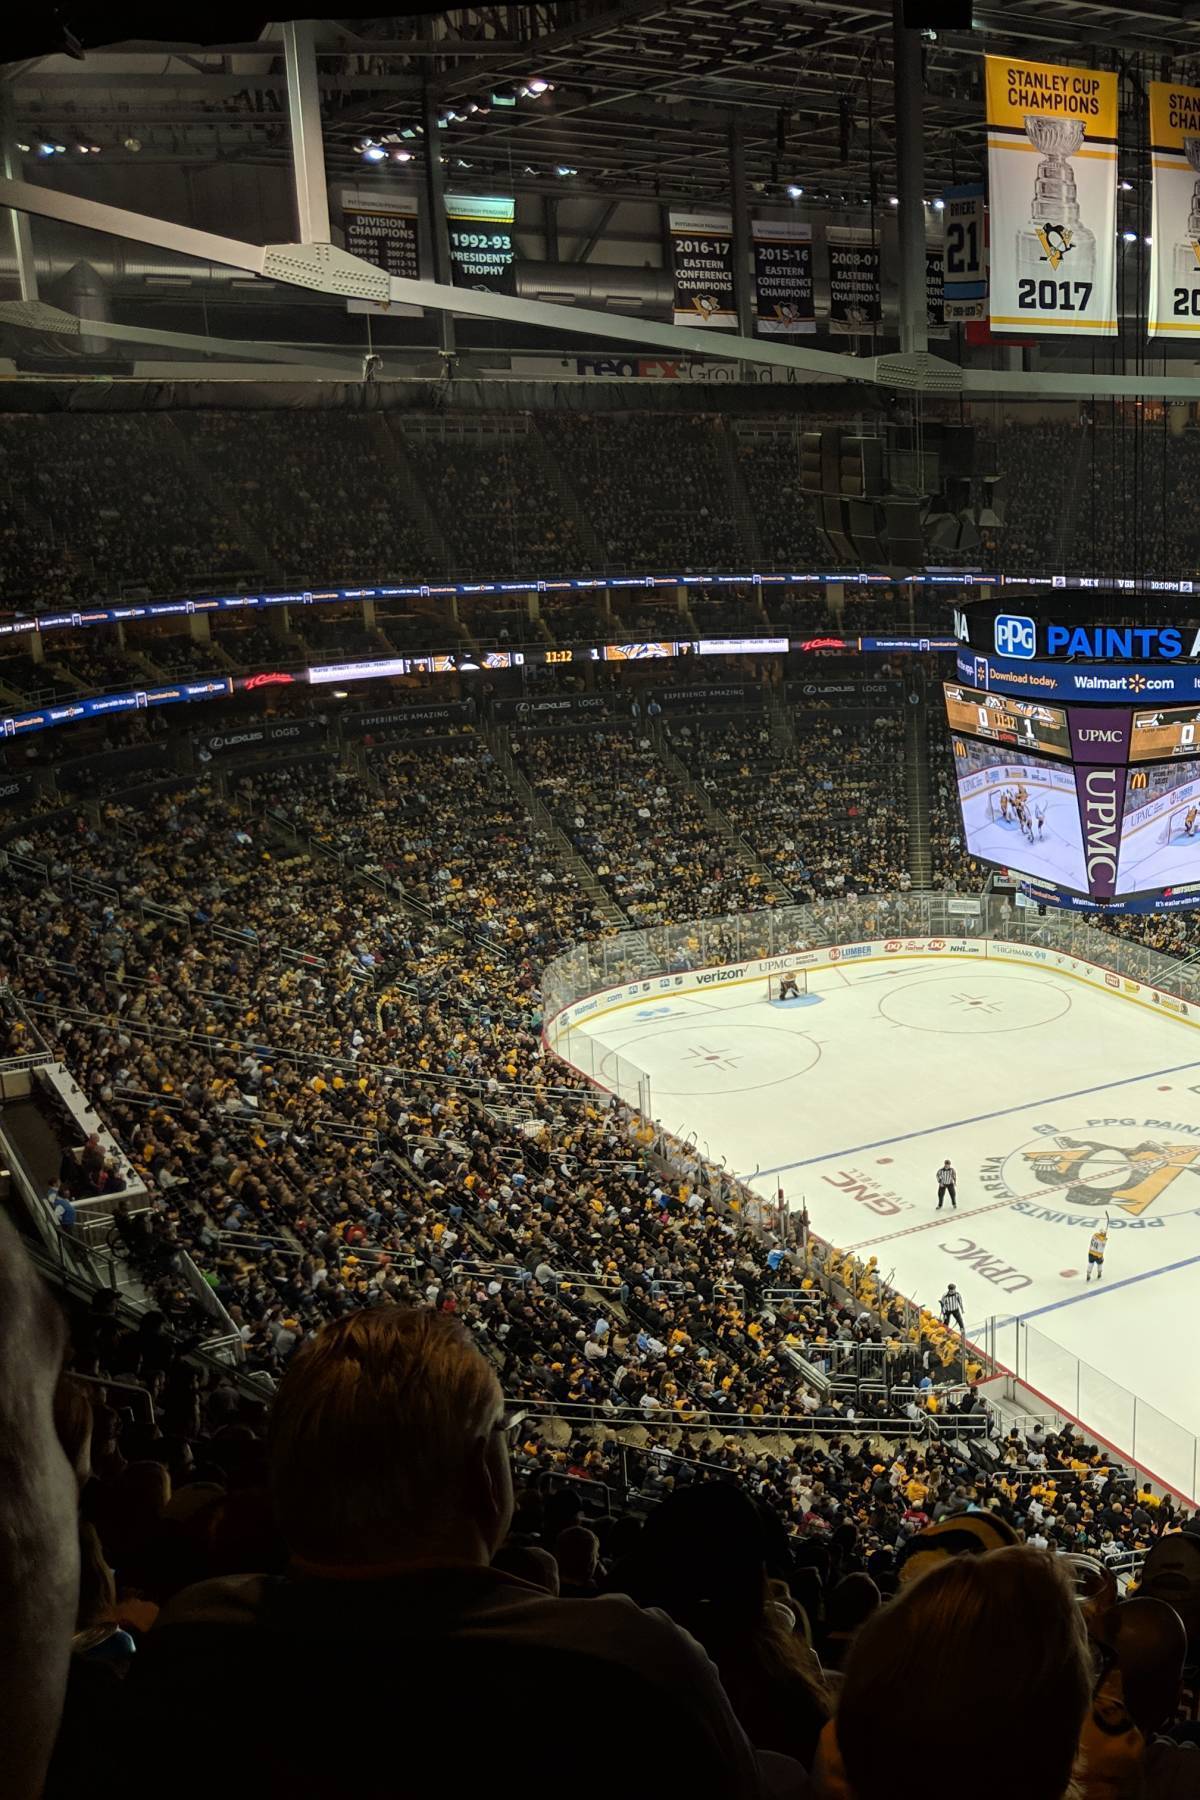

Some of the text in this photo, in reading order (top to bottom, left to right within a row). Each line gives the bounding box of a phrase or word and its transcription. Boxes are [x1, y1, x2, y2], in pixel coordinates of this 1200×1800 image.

[1007, 69, 1100, 95] STANLEY CUP
[1008, 87, 1100, 115] CHAMPIONS
[357, 216, 406, 228] DIVISION
[349, 226, 415, 239] CHAMPIONS
[452, 233, 512, 250] 1992-93
[676, 240, 730, 255] 2016-17
[947, 222, 980, 273] 21
[759, 248, 809, 261] 2015-16
[462, 264, 504, 276] TROPHY
[683, 258, 724, 269] EASTERN
[765, 266, 805, 276] EASTERN
[678, 280, 733, 291] CHAMPIONS
[1018, 278, 1093, 311] 2017
[997, 620, 1034, 653] PPG
[1048, 626, 1182, 658] PAINTS
[515, 653, 524, 665] 0
[545, 651, 573, 663] 11:12
[591, 649, 600, 660] 1
[990, 669, 1058, 689] Download today.
[1074, 676, 1175, 690] Walmart com
[664, 689, 744, 700] EXPERIENCE AMAZING
[817, 685, 887, 693] LEXUS LOGES
[531, 700, 571, 711] LEXUS
[360, 710, 449, 726] EXPERIENCE AMAZING
[978, 708, 989, 727] 0
[1024, 719, 1035, 738] 1
[1181, 725, 1194, 744] 0
[225, 727, 300, 745] LEXUS LOGES
[1078, 729, 1123, 743] UPMC
[1086, 769, 1116, 885] UPMC
[841, 945, 872, 958] LUMBER
[886, 942, 900, 951] DQ
[930, 941, 944, 949] DQ
[950, 945, 980, 953] NHL.com
[996, 946, 1033, 958] HIGHMARK
[759, 958, 793, 973] UPMC
[696, 970, 744, 985] verizon
[574, 992, 623, 1017] Walmart com
[1087, 1118, 1136, 1128] PPG
[980, 1155, 1016, 1200] ARENA
[821, 1170, 902, 1216] GNC
[1009, 1200, 1166, 1229] PPG PAINTS
[938, 1238, 1033, 1294] UPMC
